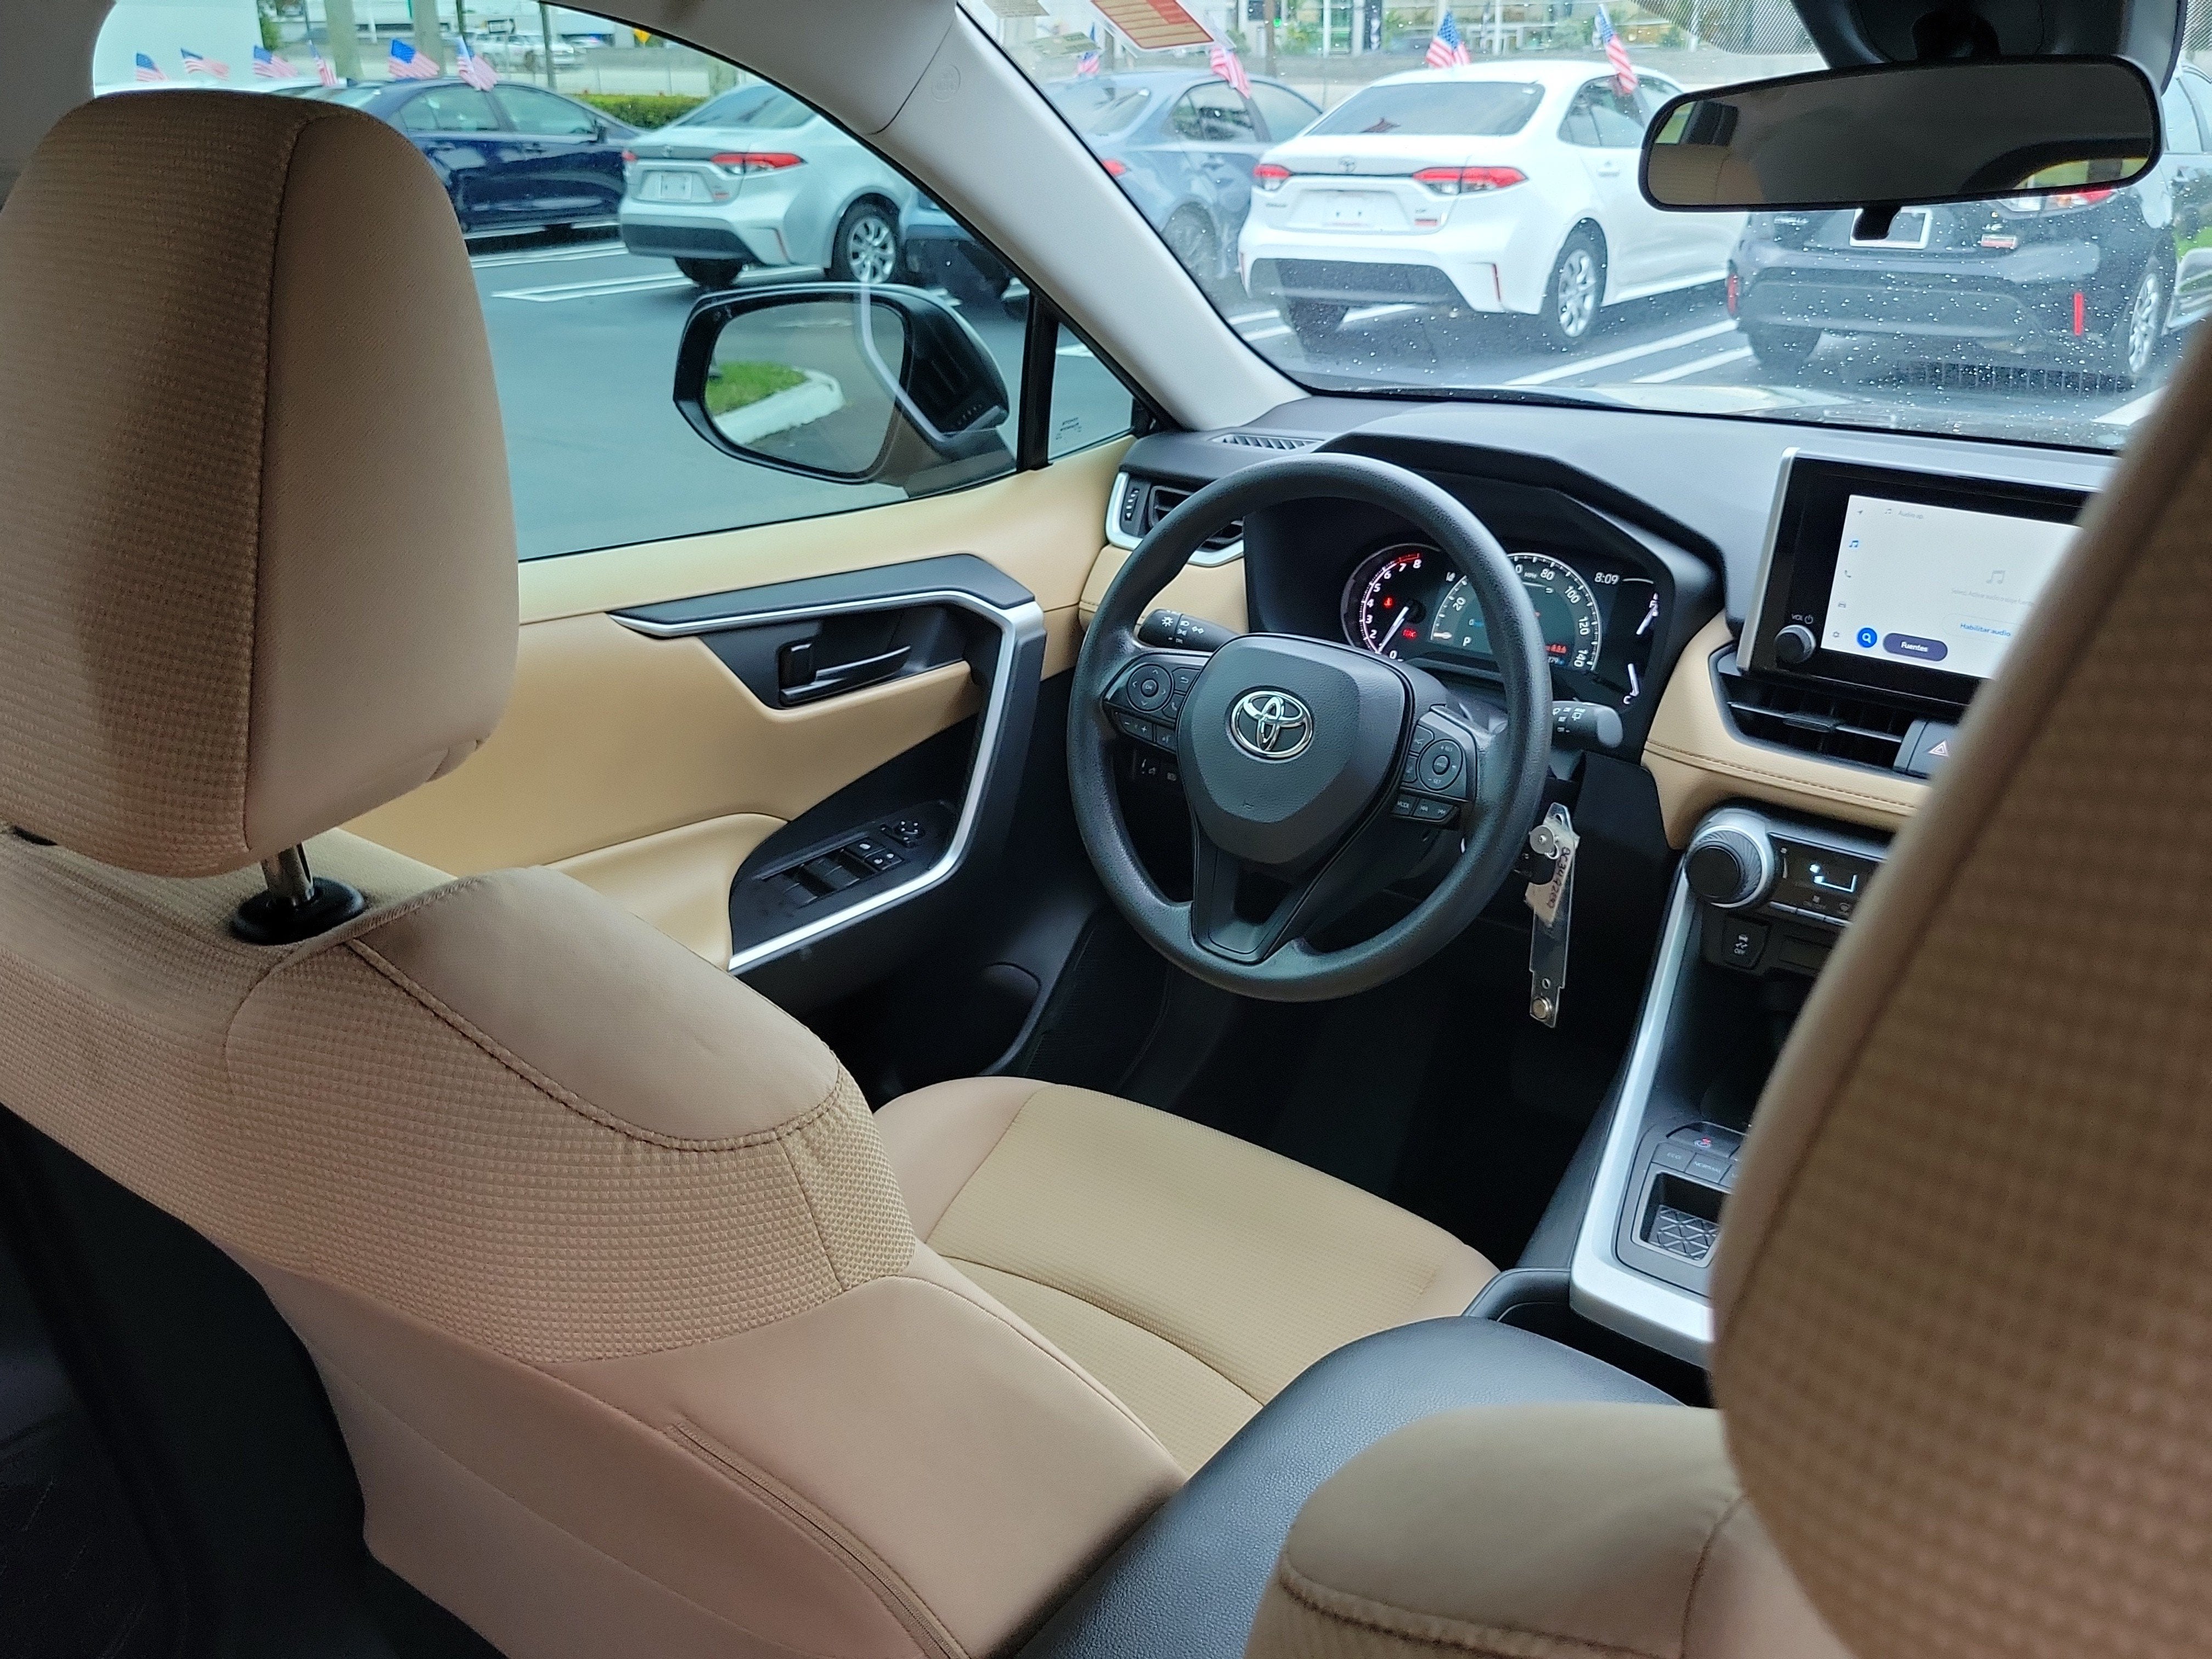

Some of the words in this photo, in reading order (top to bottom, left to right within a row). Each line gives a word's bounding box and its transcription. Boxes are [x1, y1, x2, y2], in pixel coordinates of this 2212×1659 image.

[1398, 563, 1407, 572] 7
[1413, 559, 1422, 569] 8
[1384, 570, 1392, 579] 6
[1540, 568, 1555, 581] 80
[1594, 572, 1620, 585] 8:09
[1373, 583, 1381, 592] 5
[1564, 585, 1581, 603] 100
[1367, 599, 1374, 608] 4
[1452, 597, 1466, 612] 20
[1365, 614, 1373, 624] 3
[1578, 616, 1591, 636] 120
[1960, 623, 1990, 633] Habilitar
[1369, 629, 1377, 639] 2
[1463, 636, 1472, 647] P
[1900, 641, 1928, 652] Fuentes
[1389, 650, 1398, 659] 0
[1573, 650, 1589, 668] 140
[1623, 695, 1631, 704] C
